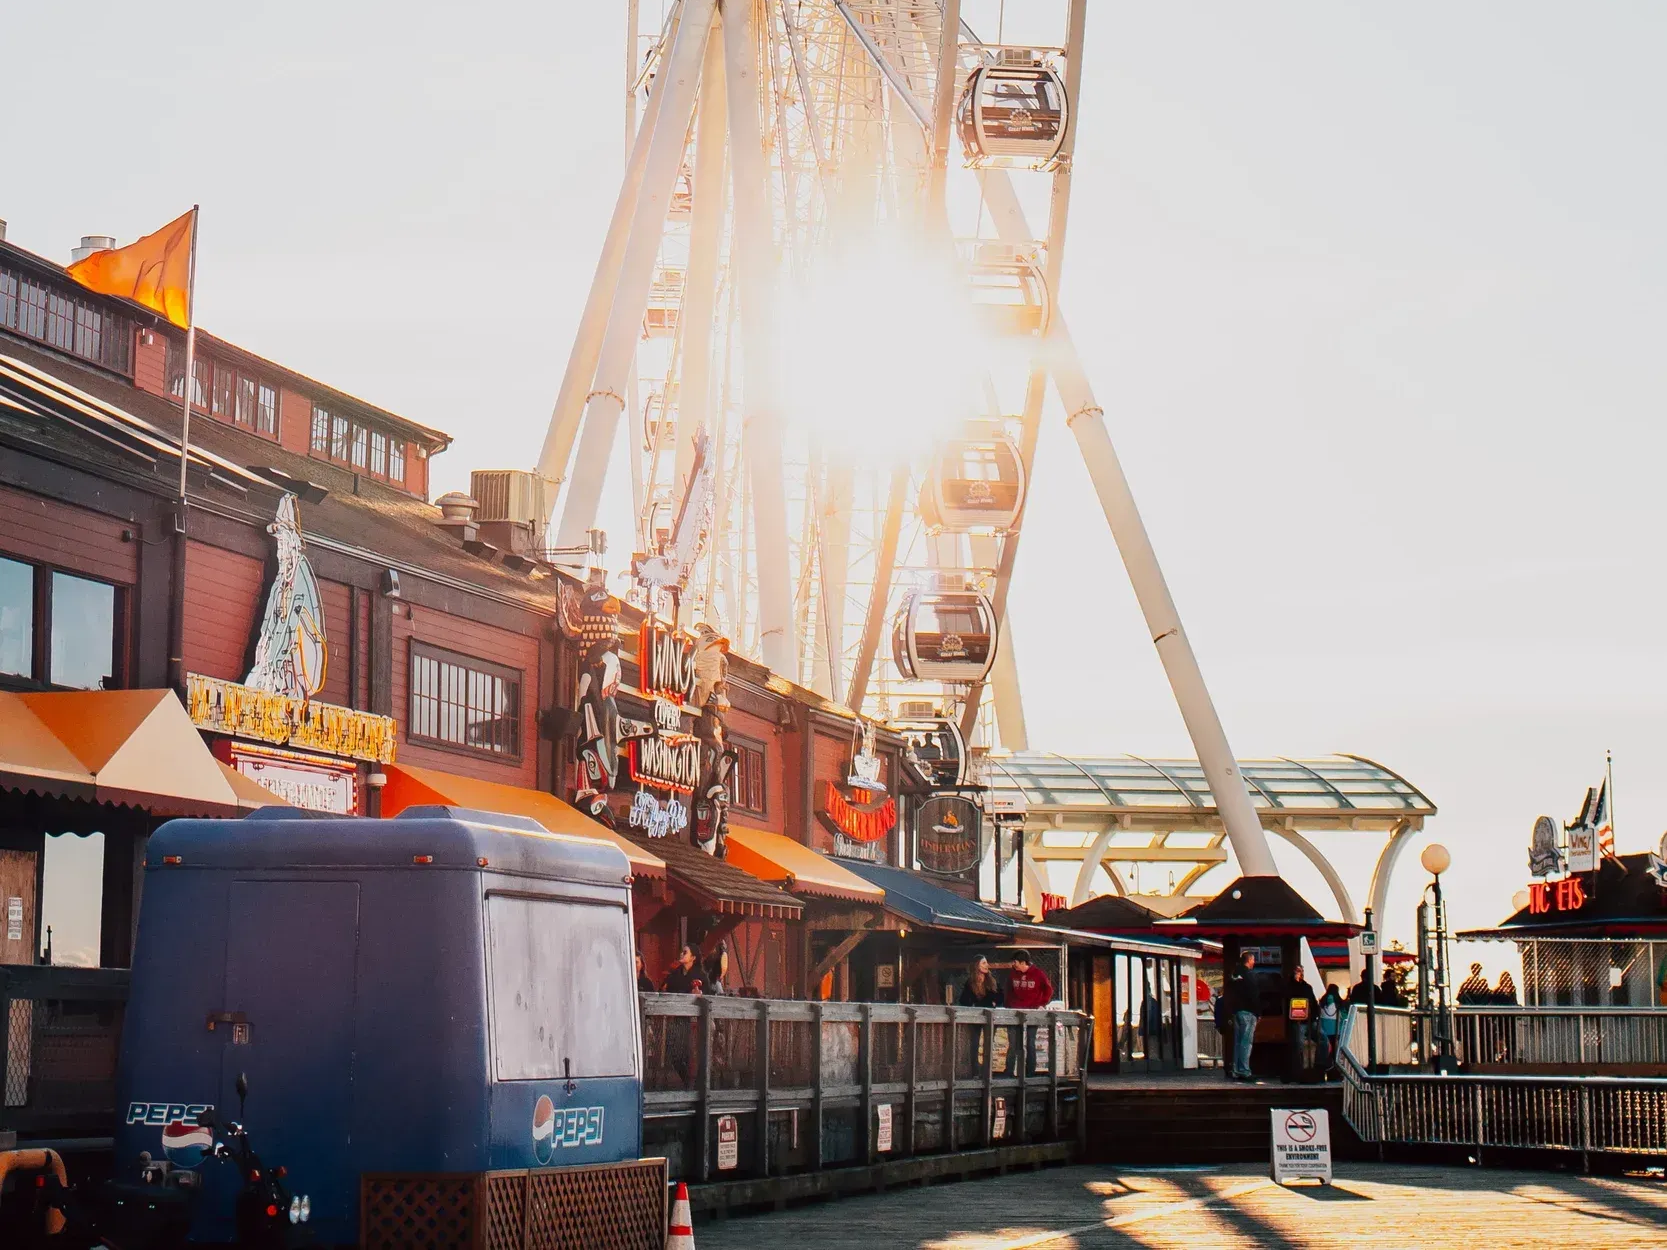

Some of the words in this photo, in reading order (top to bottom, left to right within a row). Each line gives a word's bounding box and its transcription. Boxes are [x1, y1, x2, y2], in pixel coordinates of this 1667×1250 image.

[655, 699, 680, 731] OVER
[641, 737, 701, 788] WASHINGTON
[1527, 878, 1584, 914] TICETS
[126, 1101, 215, 1127] PEPS
[551, 1106, 604, 1149] PEPSI
